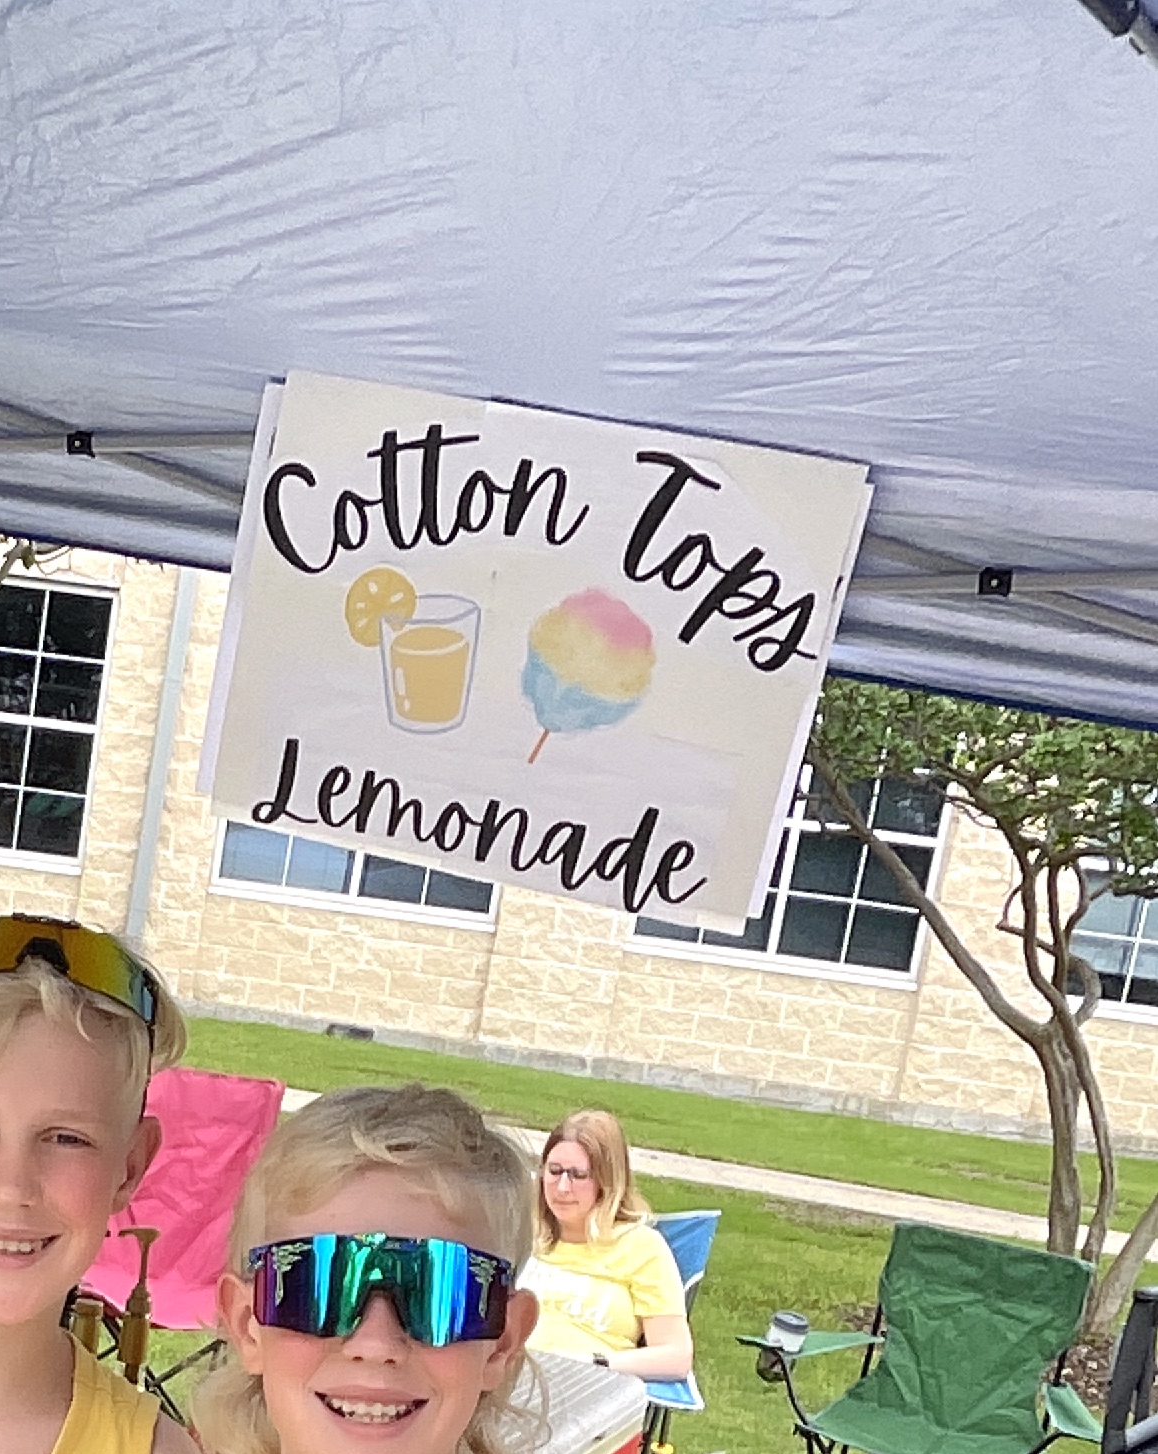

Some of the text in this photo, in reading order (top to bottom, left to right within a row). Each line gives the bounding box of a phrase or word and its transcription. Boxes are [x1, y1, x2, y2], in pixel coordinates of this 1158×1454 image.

[263, 424, 818, 673] Cotton Tops
[251, 738, 708, 913] Lemonade
